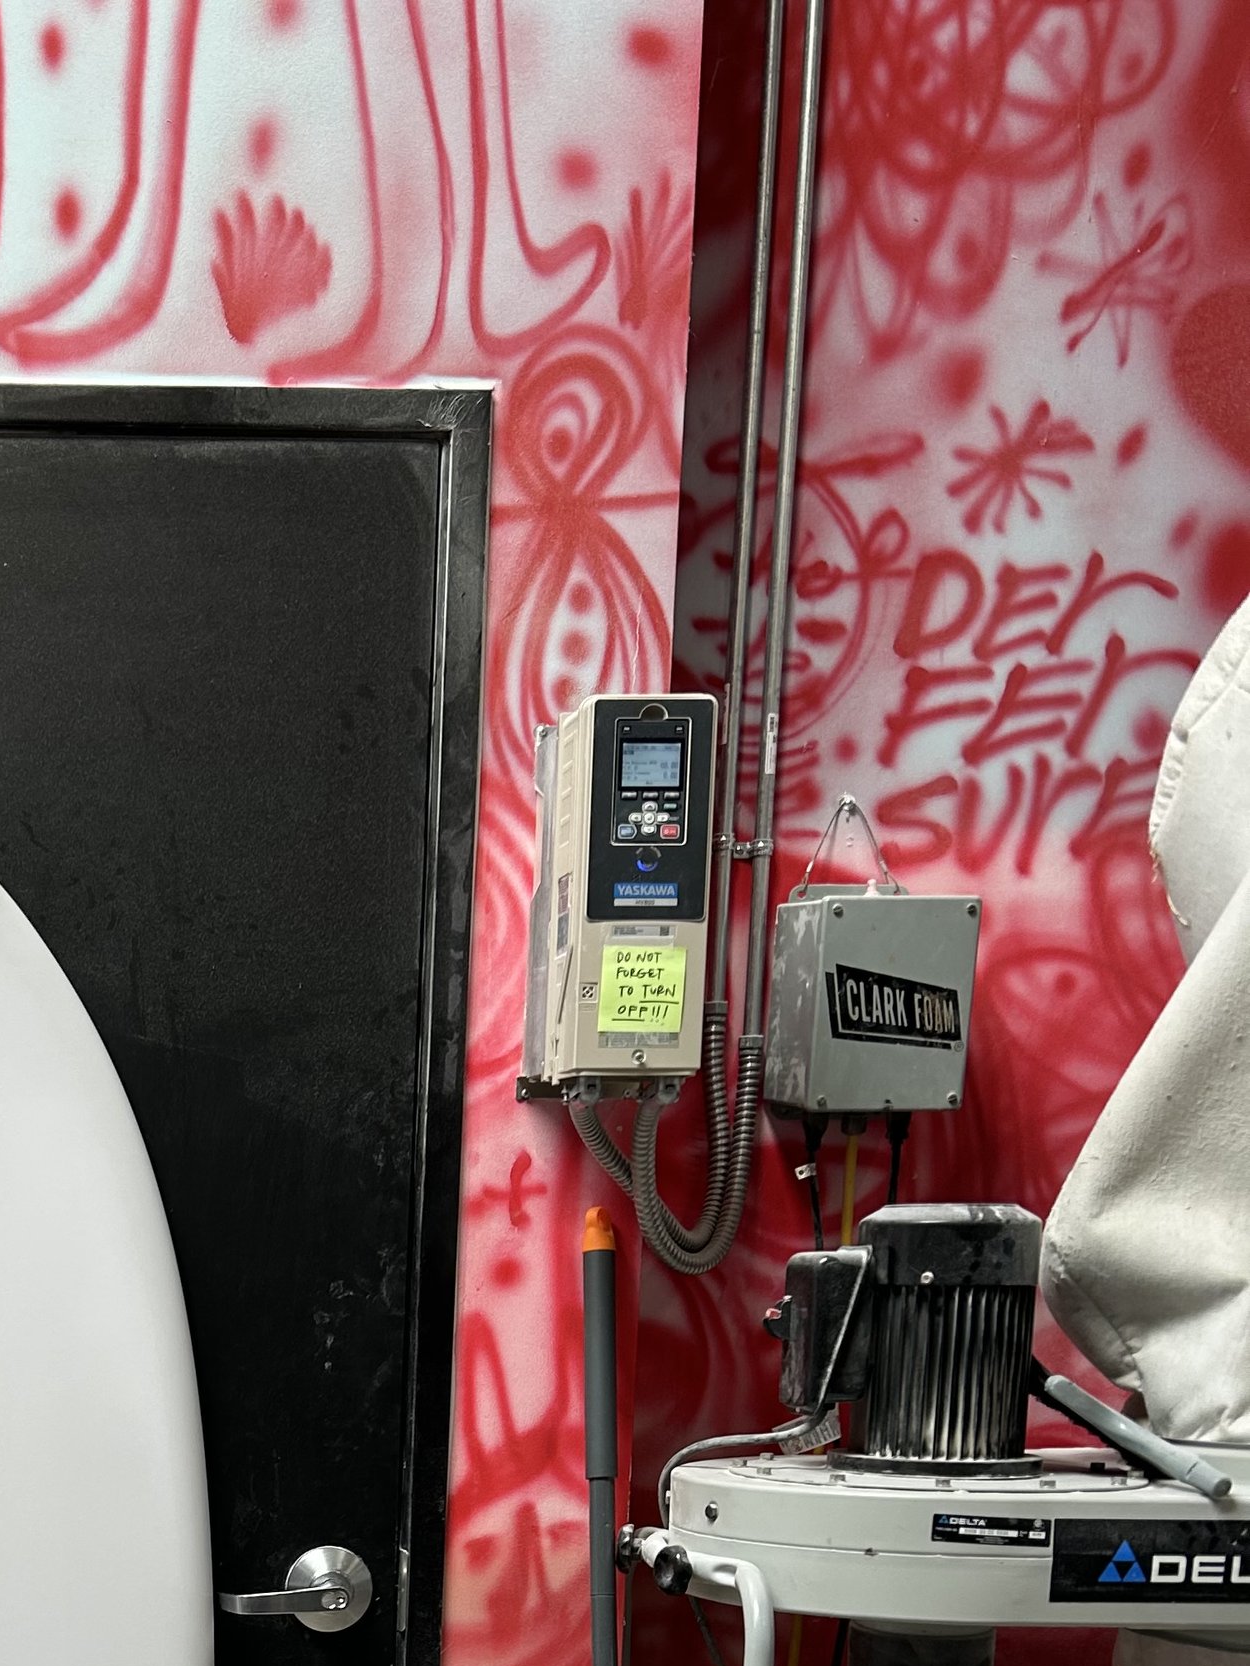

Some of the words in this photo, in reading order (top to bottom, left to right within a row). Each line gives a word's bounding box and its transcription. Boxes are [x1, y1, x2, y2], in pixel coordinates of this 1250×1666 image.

[617, 884, 676, 897] YASKAWA
[616, 951, 632, 964] DO
[636, 951, 662, 964] NOT
[616, 967, 664, 980] FORGET
[618, 985, 634, 998] TO
[642, 984, 676, 999] TURN
[846, 978, 908, 1028] CLARK
[913, 993, 956, 1034] FOAM
[949, 1516, 986, 1526] DELTA
